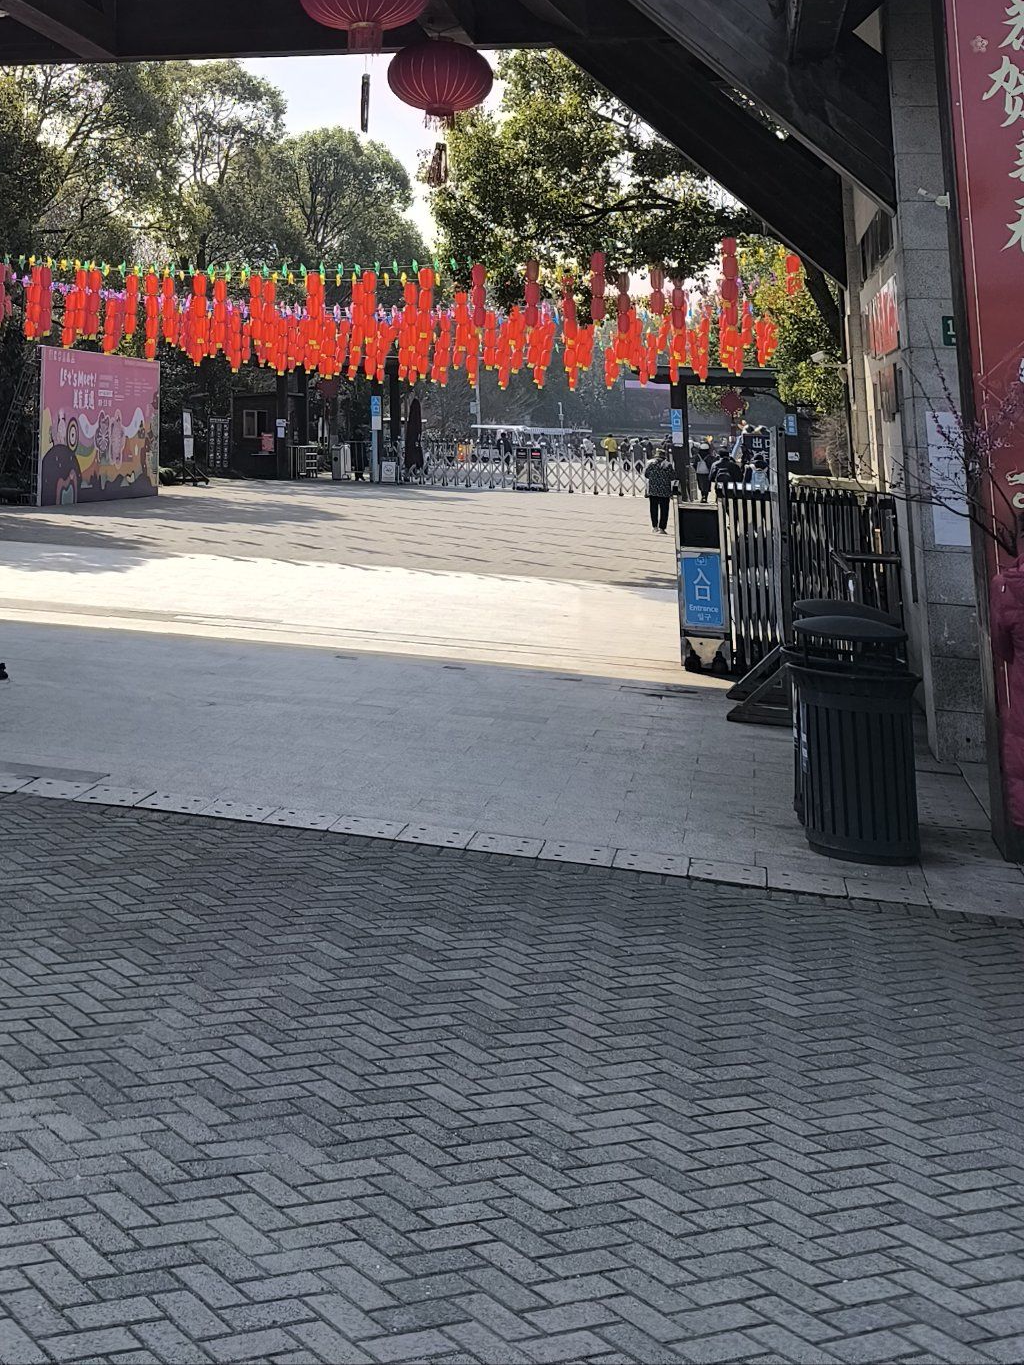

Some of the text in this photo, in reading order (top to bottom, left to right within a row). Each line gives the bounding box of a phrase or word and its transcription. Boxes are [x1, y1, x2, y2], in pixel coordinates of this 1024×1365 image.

[672, 411, 681, 425] 入口
[693, 568, 711, 601] 入口
[689, 604, 718, 613] Entrance
